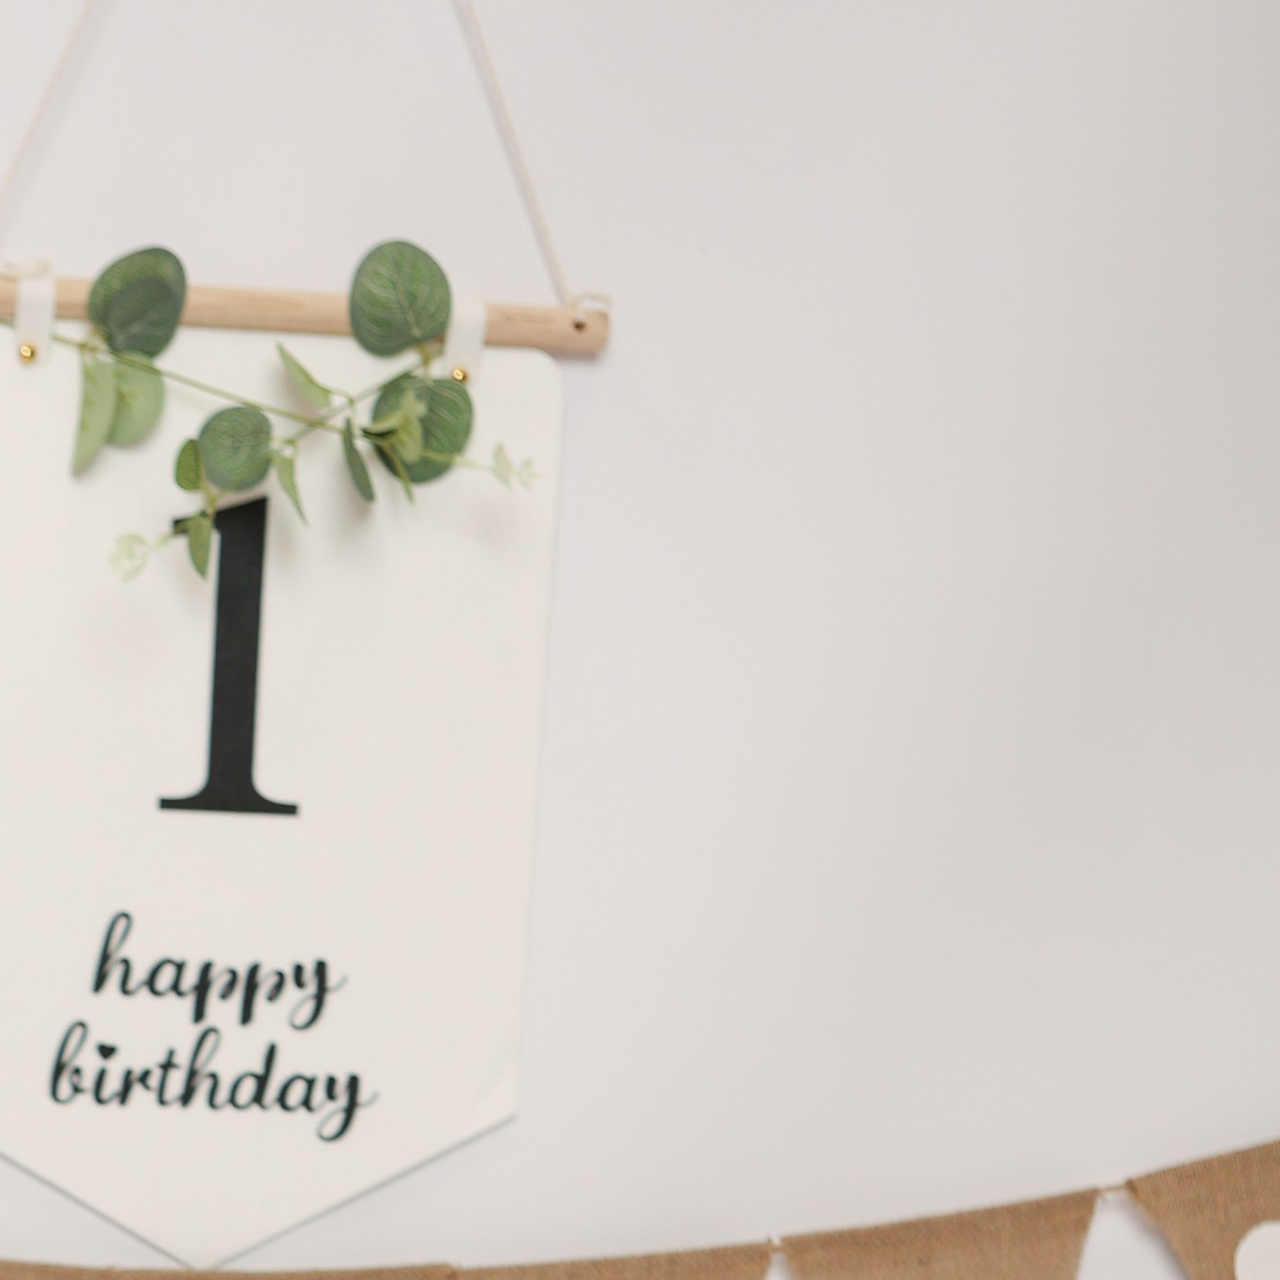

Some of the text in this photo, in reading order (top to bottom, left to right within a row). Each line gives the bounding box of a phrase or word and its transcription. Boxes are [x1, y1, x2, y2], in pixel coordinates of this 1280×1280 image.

[158, 495, 299, 816] 1
[90, 910, 347, 1031] happy
[47, 1020, 379, 1144] birthday
